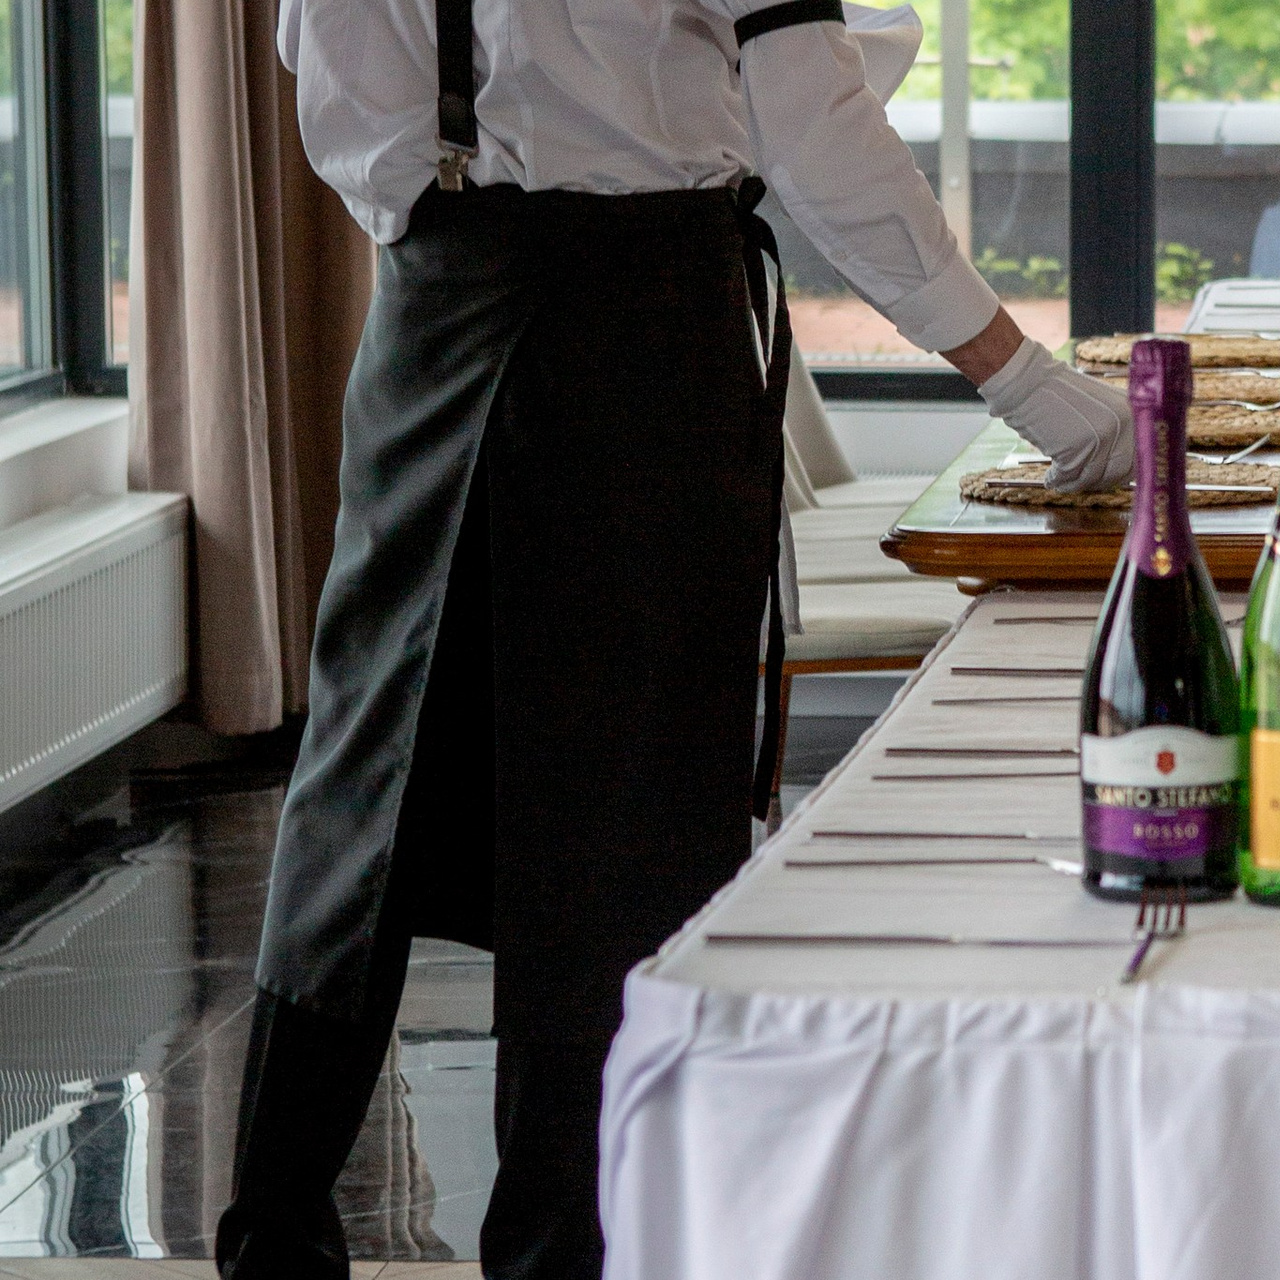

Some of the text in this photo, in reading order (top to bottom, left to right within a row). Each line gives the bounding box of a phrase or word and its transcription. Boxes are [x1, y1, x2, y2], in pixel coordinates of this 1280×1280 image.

[1094, 783, 1233, 808] SANTO STEFANO
[1133, 822, 1199, 839] ROSSO
